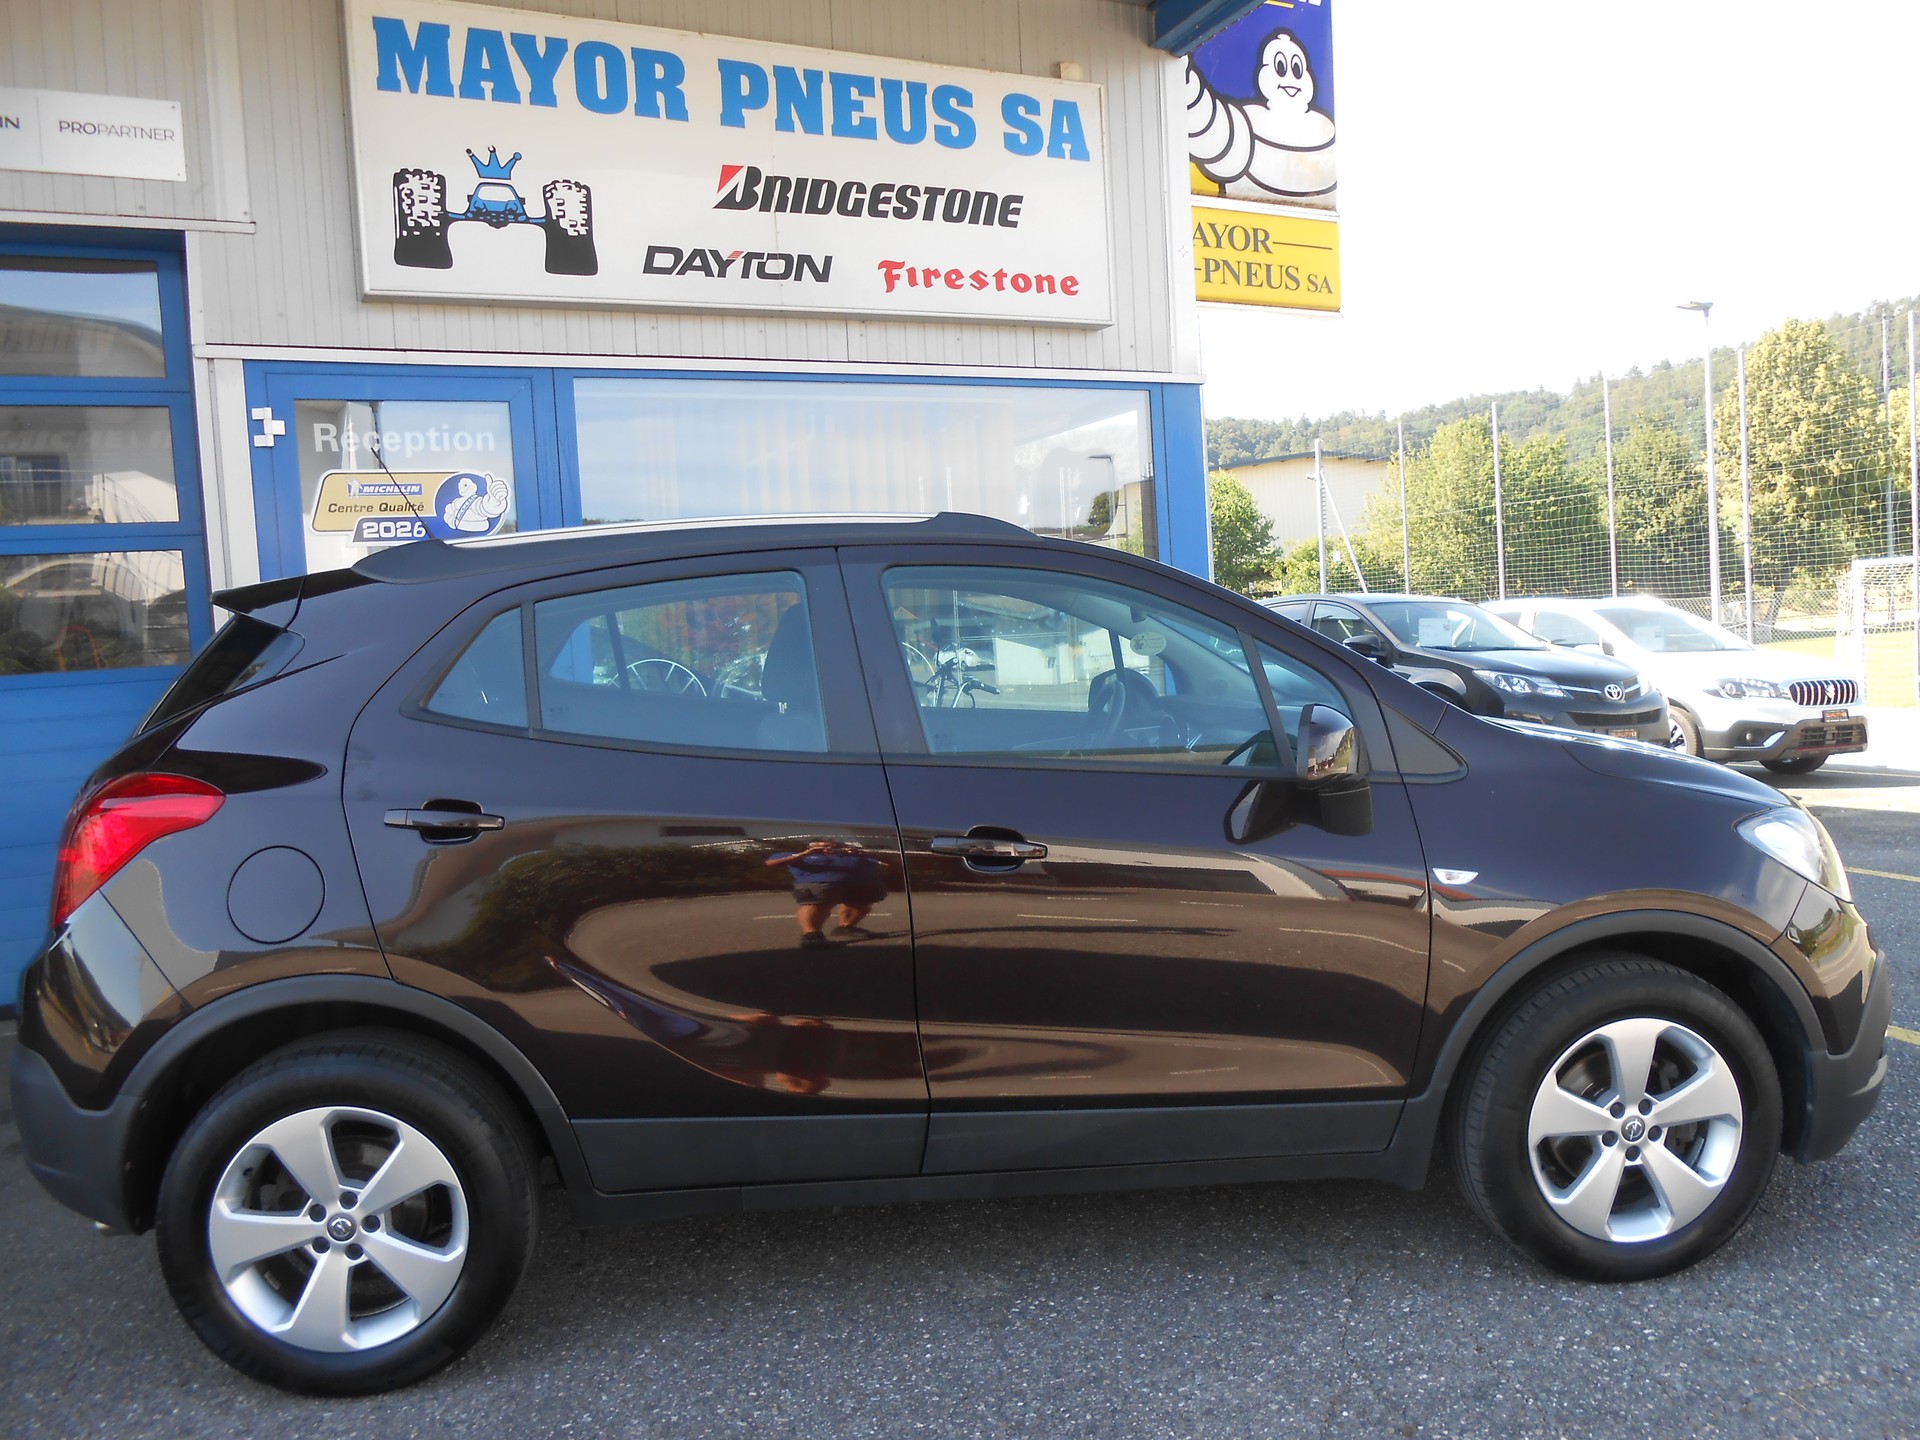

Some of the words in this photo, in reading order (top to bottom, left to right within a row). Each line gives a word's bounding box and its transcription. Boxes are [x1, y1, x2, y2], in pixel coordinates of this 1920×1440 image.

[372, 16, 688, 122] MAYOR
[718, 58, 976, 151] PNEUS
[1001, 92, 1089, 162] SA
[58, 119, 175, 142] PROPARTNER
[713, 164, 1023, 228] BRIDGESTONE
[1193, 221, 1273, 255] AYOR
[643, 245, 832, 283] DAYTON
[877, 260, 1079, 297] Firestone
[1203, 257, 1300, 292] PNEUS
[1307, 274, 1333, 295] SA
[313, 421, 496, 458] Réception
[328, 503, 373, 513] Centre
[379, 501, 424, 514] Qualité
[362, 484, 421, 494] MICHELIN
[363, 520, 427, 538] 2026
